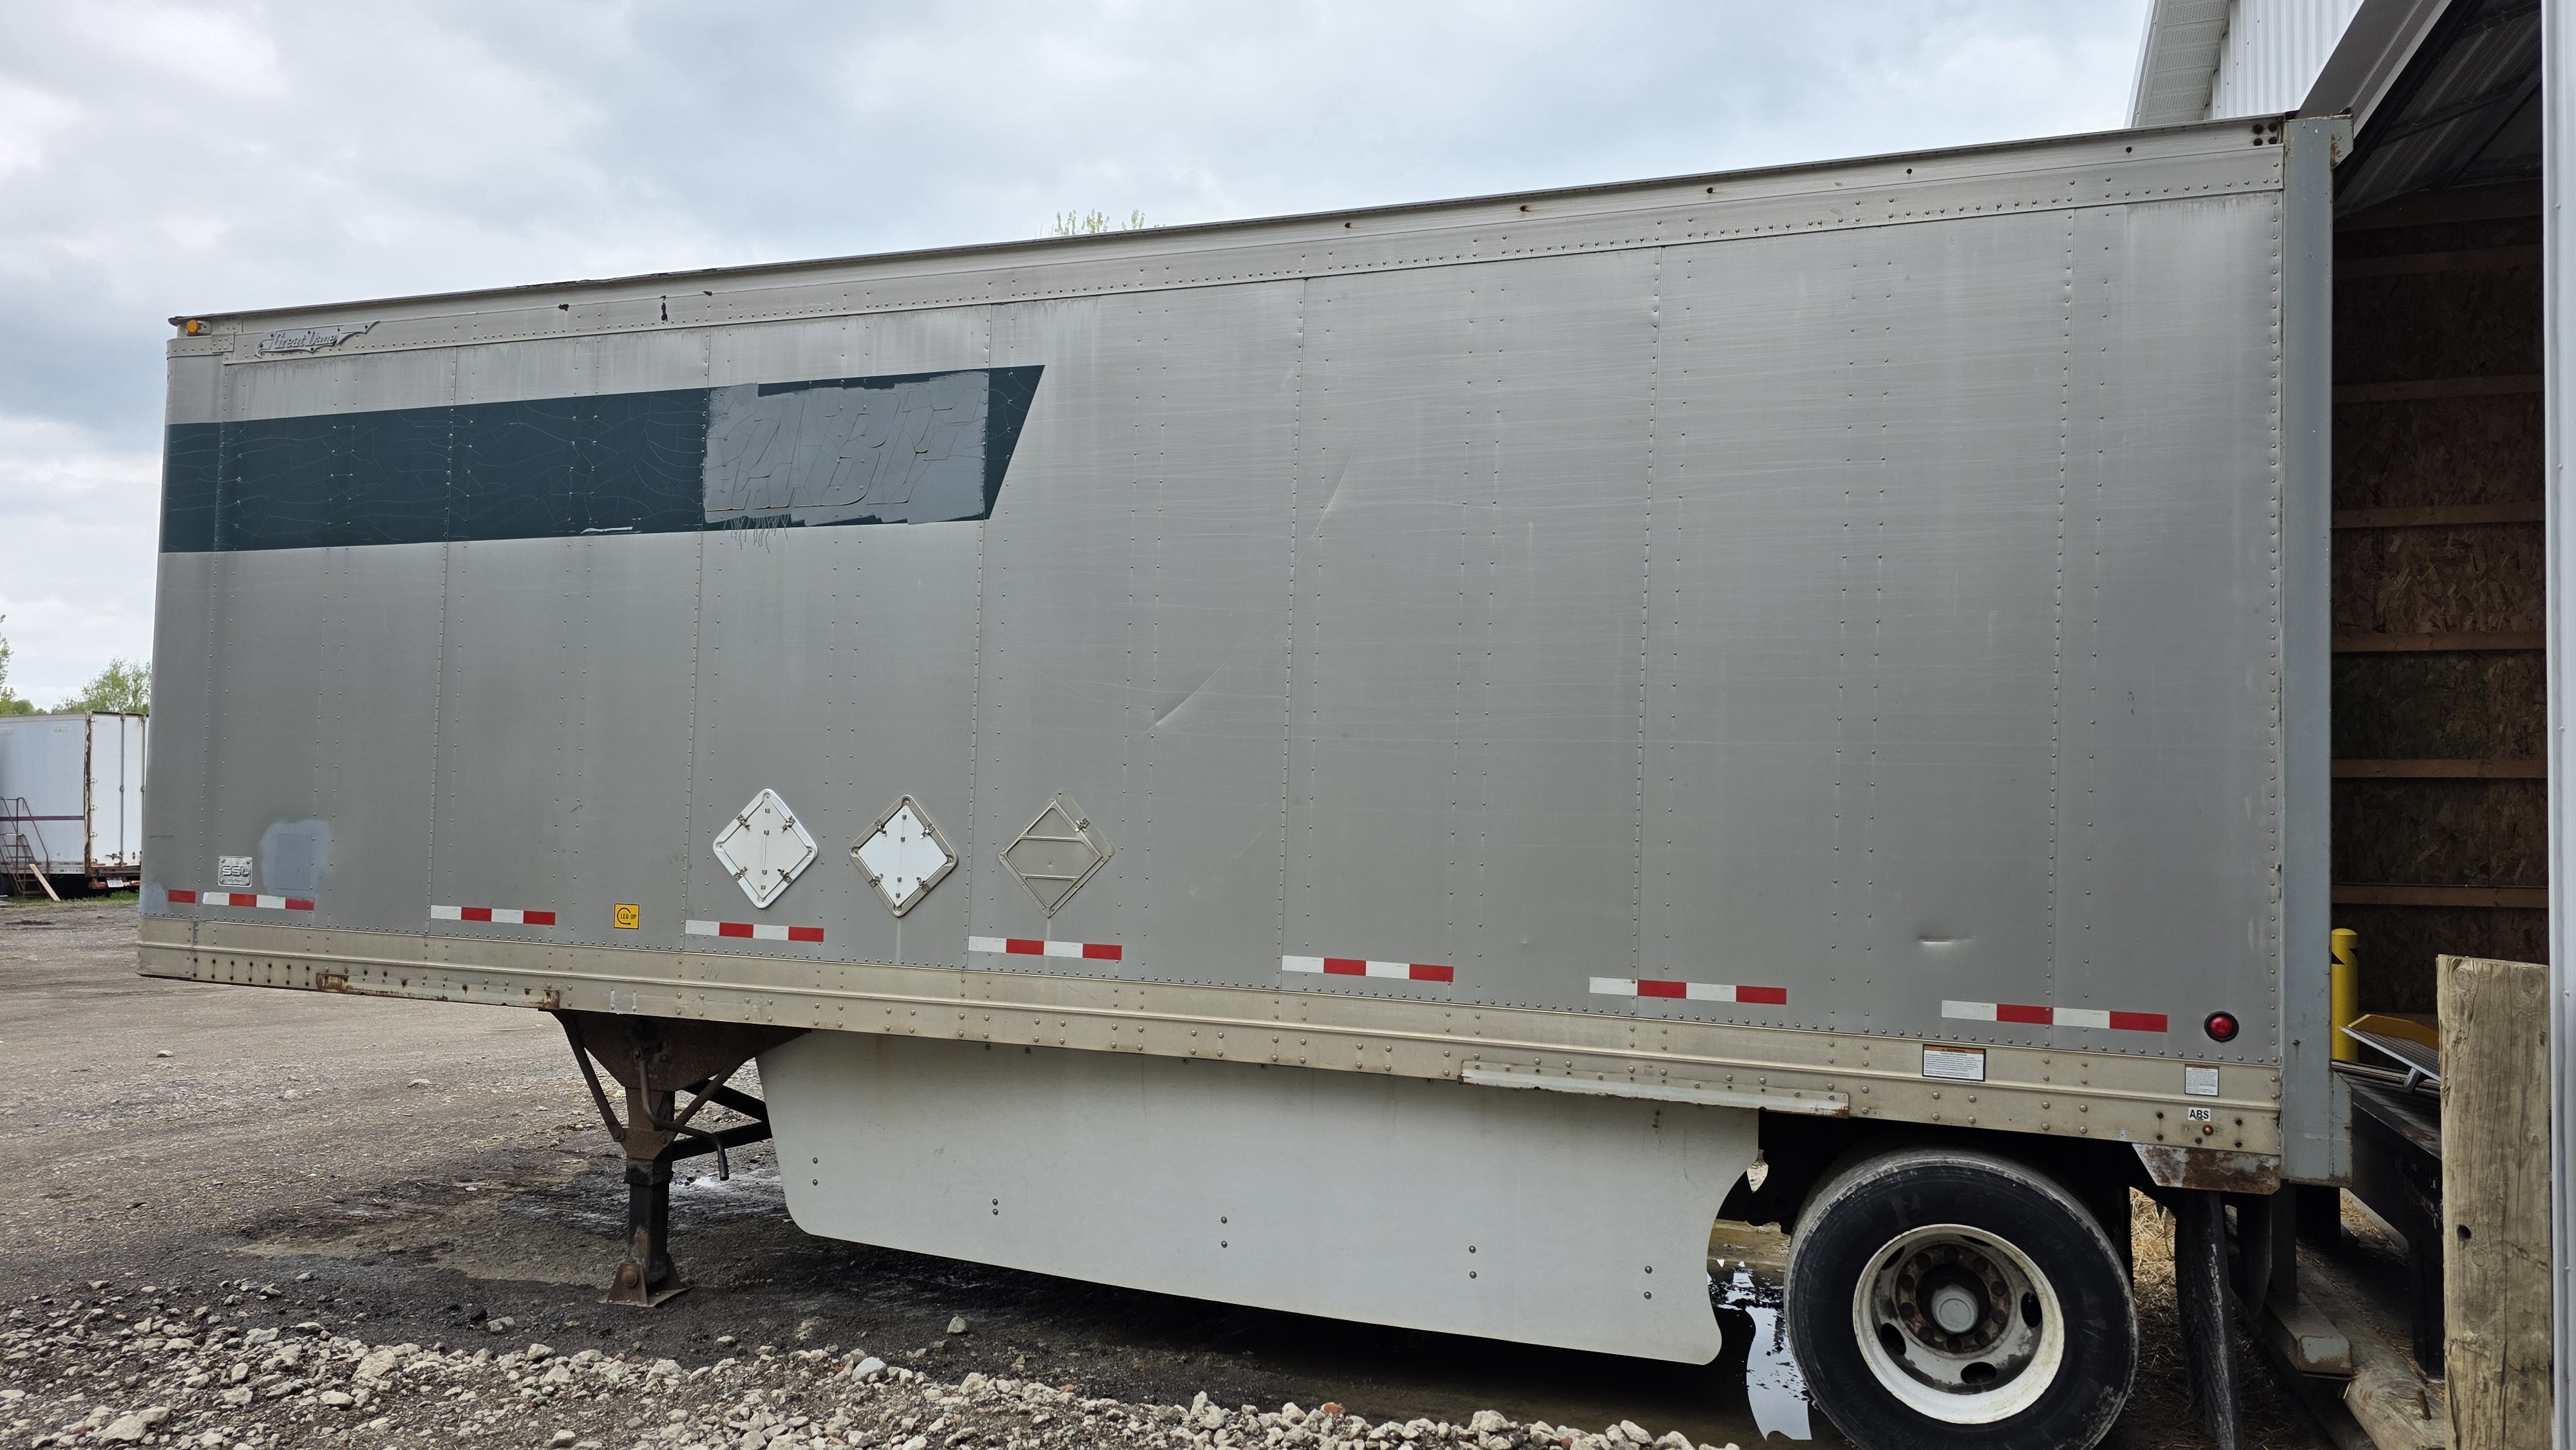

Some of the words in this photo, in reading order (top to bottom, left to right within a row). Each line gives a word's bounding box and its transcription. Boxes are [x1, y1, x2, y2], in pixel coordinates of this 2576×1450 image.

[274, 332, 306, 349] Great
[305, 331, 337, 347] Dane
[2189, 1109, 2210, 1120] ABS
